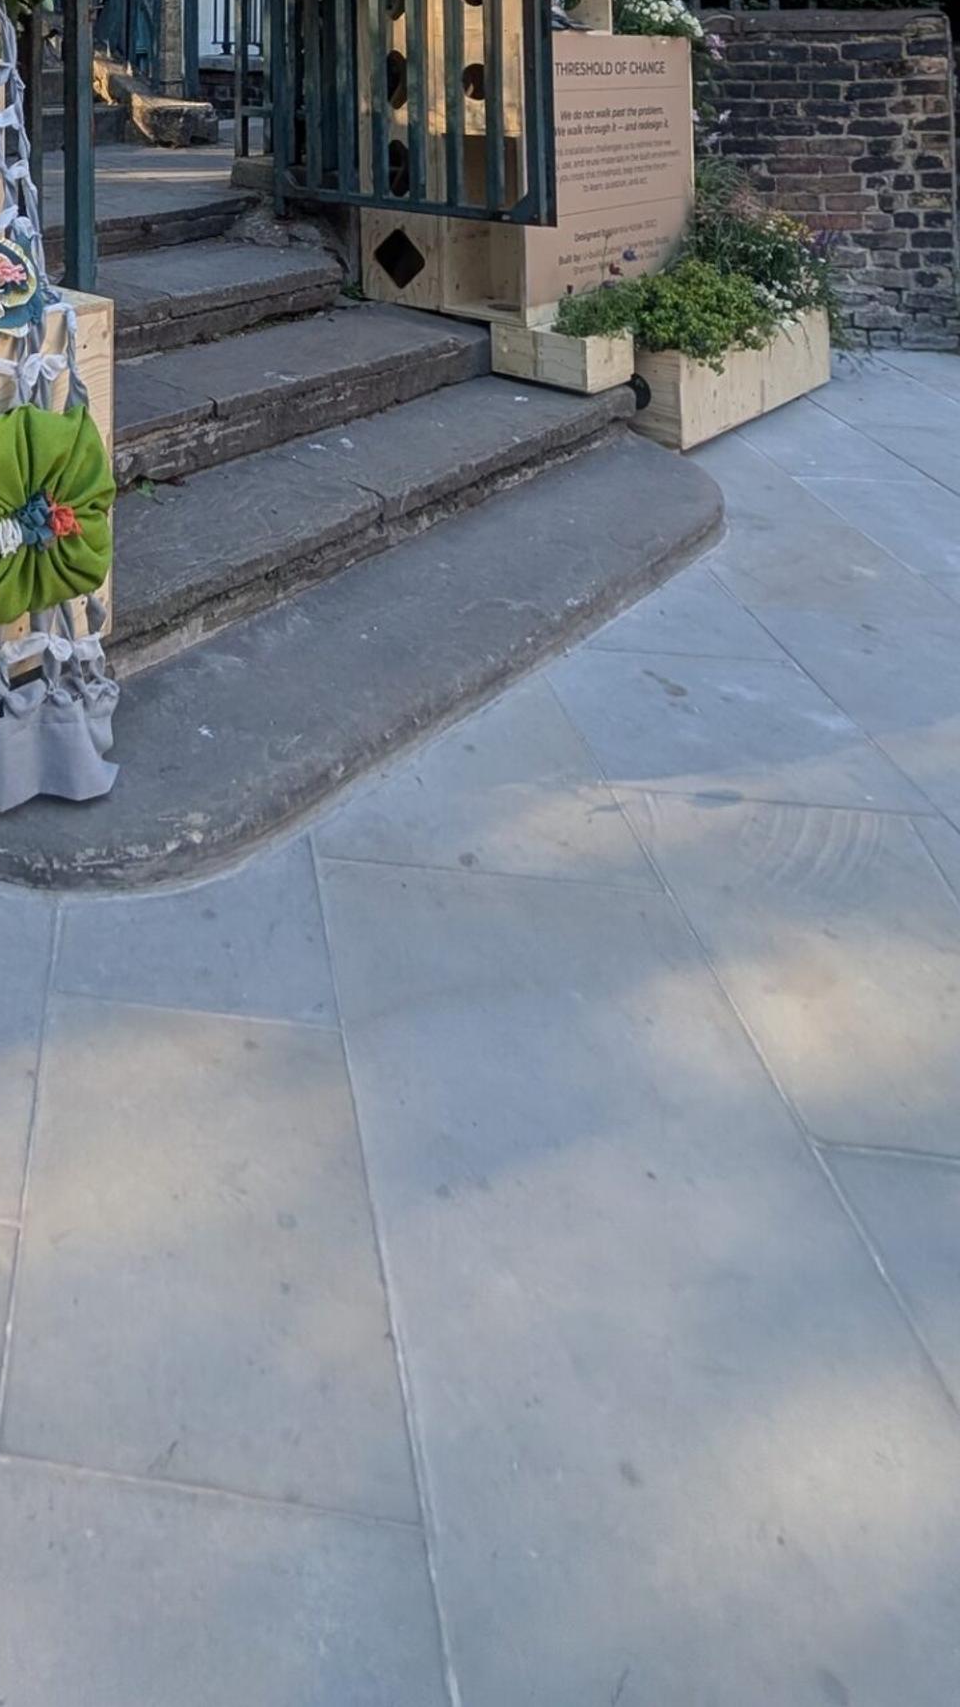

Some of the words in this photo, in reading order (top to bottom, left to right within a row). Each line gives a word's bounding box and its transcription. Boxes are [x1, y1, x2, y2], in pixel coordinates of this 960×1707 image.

[555, 61, 613, 76] THRESHOLD
[615, 61, 627, 75] OF
[629, 61, 666, 75] CHANGE
[560, 111, 571, 121] We
[573, 110, 581, 120] do
[582, 109, 595, 120] not
[596, 108, 611, 119] walk
[612, 108, 626, 119] past
[627, 107, 637, 117] the
[567, 124, 582, 135] walk
[584, 122, 611, 136] through
[625, 121, 637, 131] and
[638, 120, 663, 132] redesign
[574, 230, 600, 243] Designed
